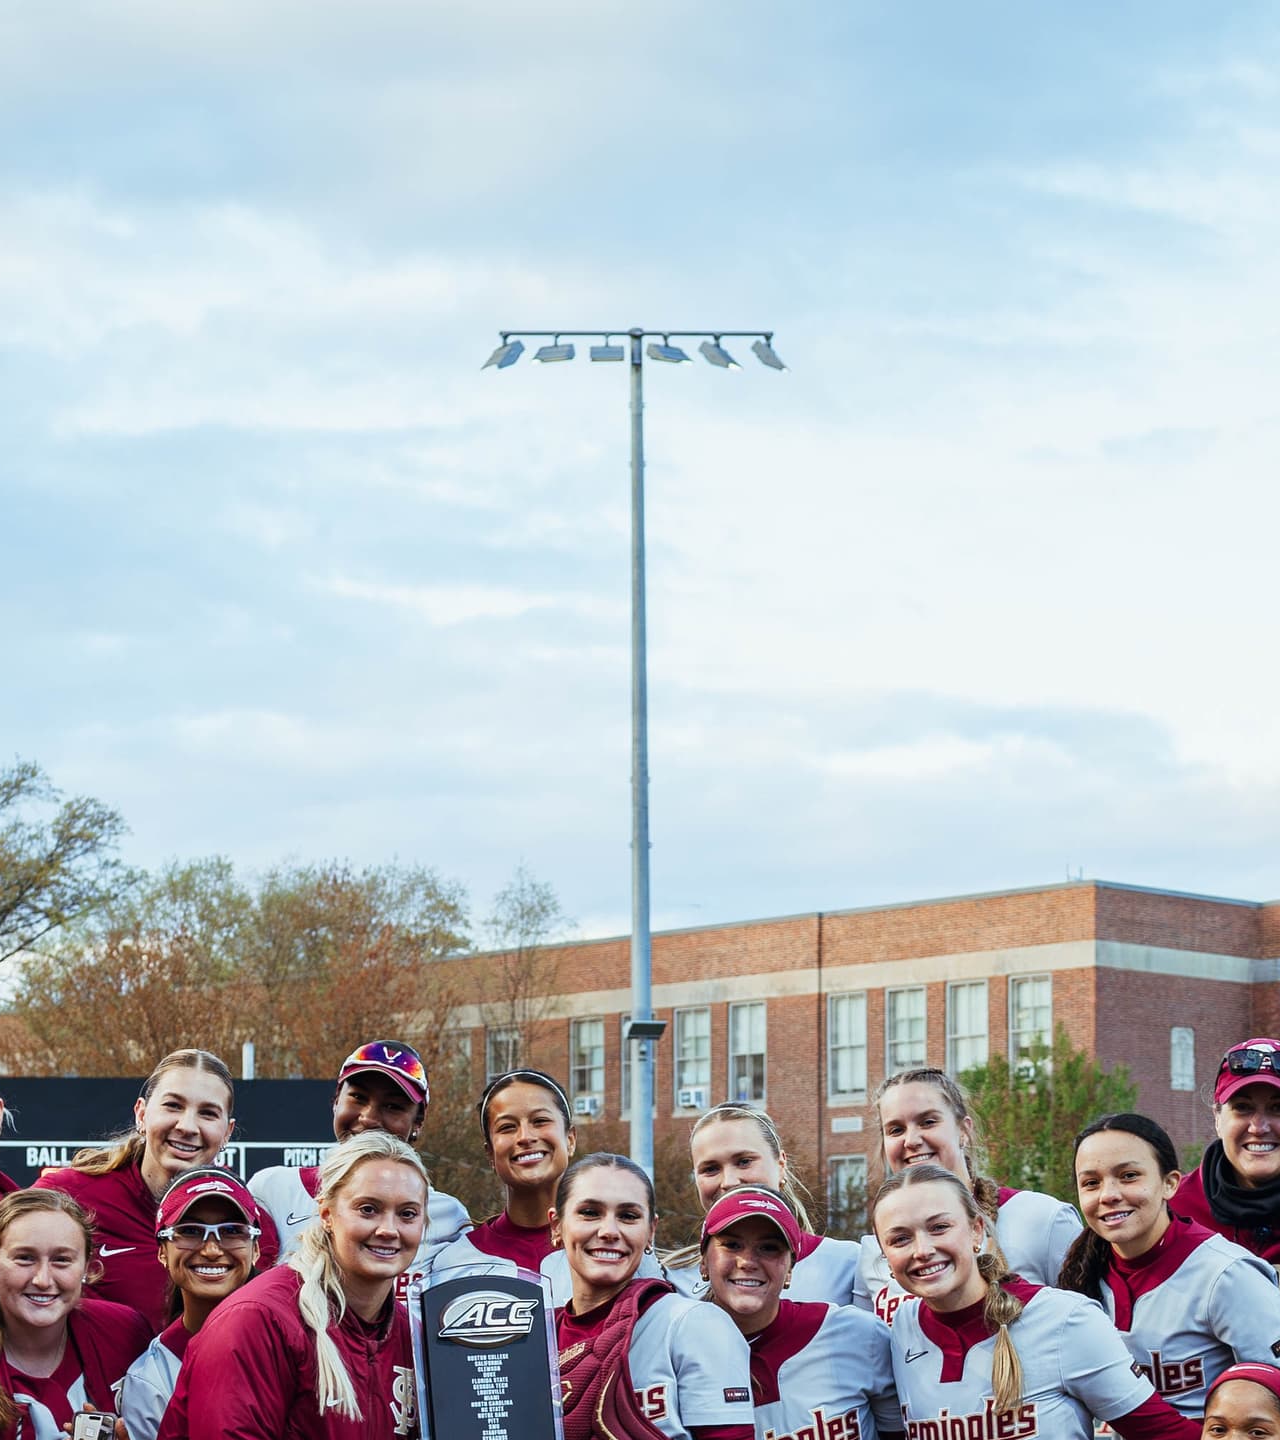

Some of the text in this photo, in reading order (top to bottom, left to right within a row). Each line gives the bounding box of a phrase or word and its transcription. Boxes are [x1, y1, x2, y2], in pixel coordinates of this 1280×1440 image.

[26, 1147, 72, 1167] BALL
[283, 1148, 317, 1167] PITCH
[439, 1300, 539, 1337] ACC
